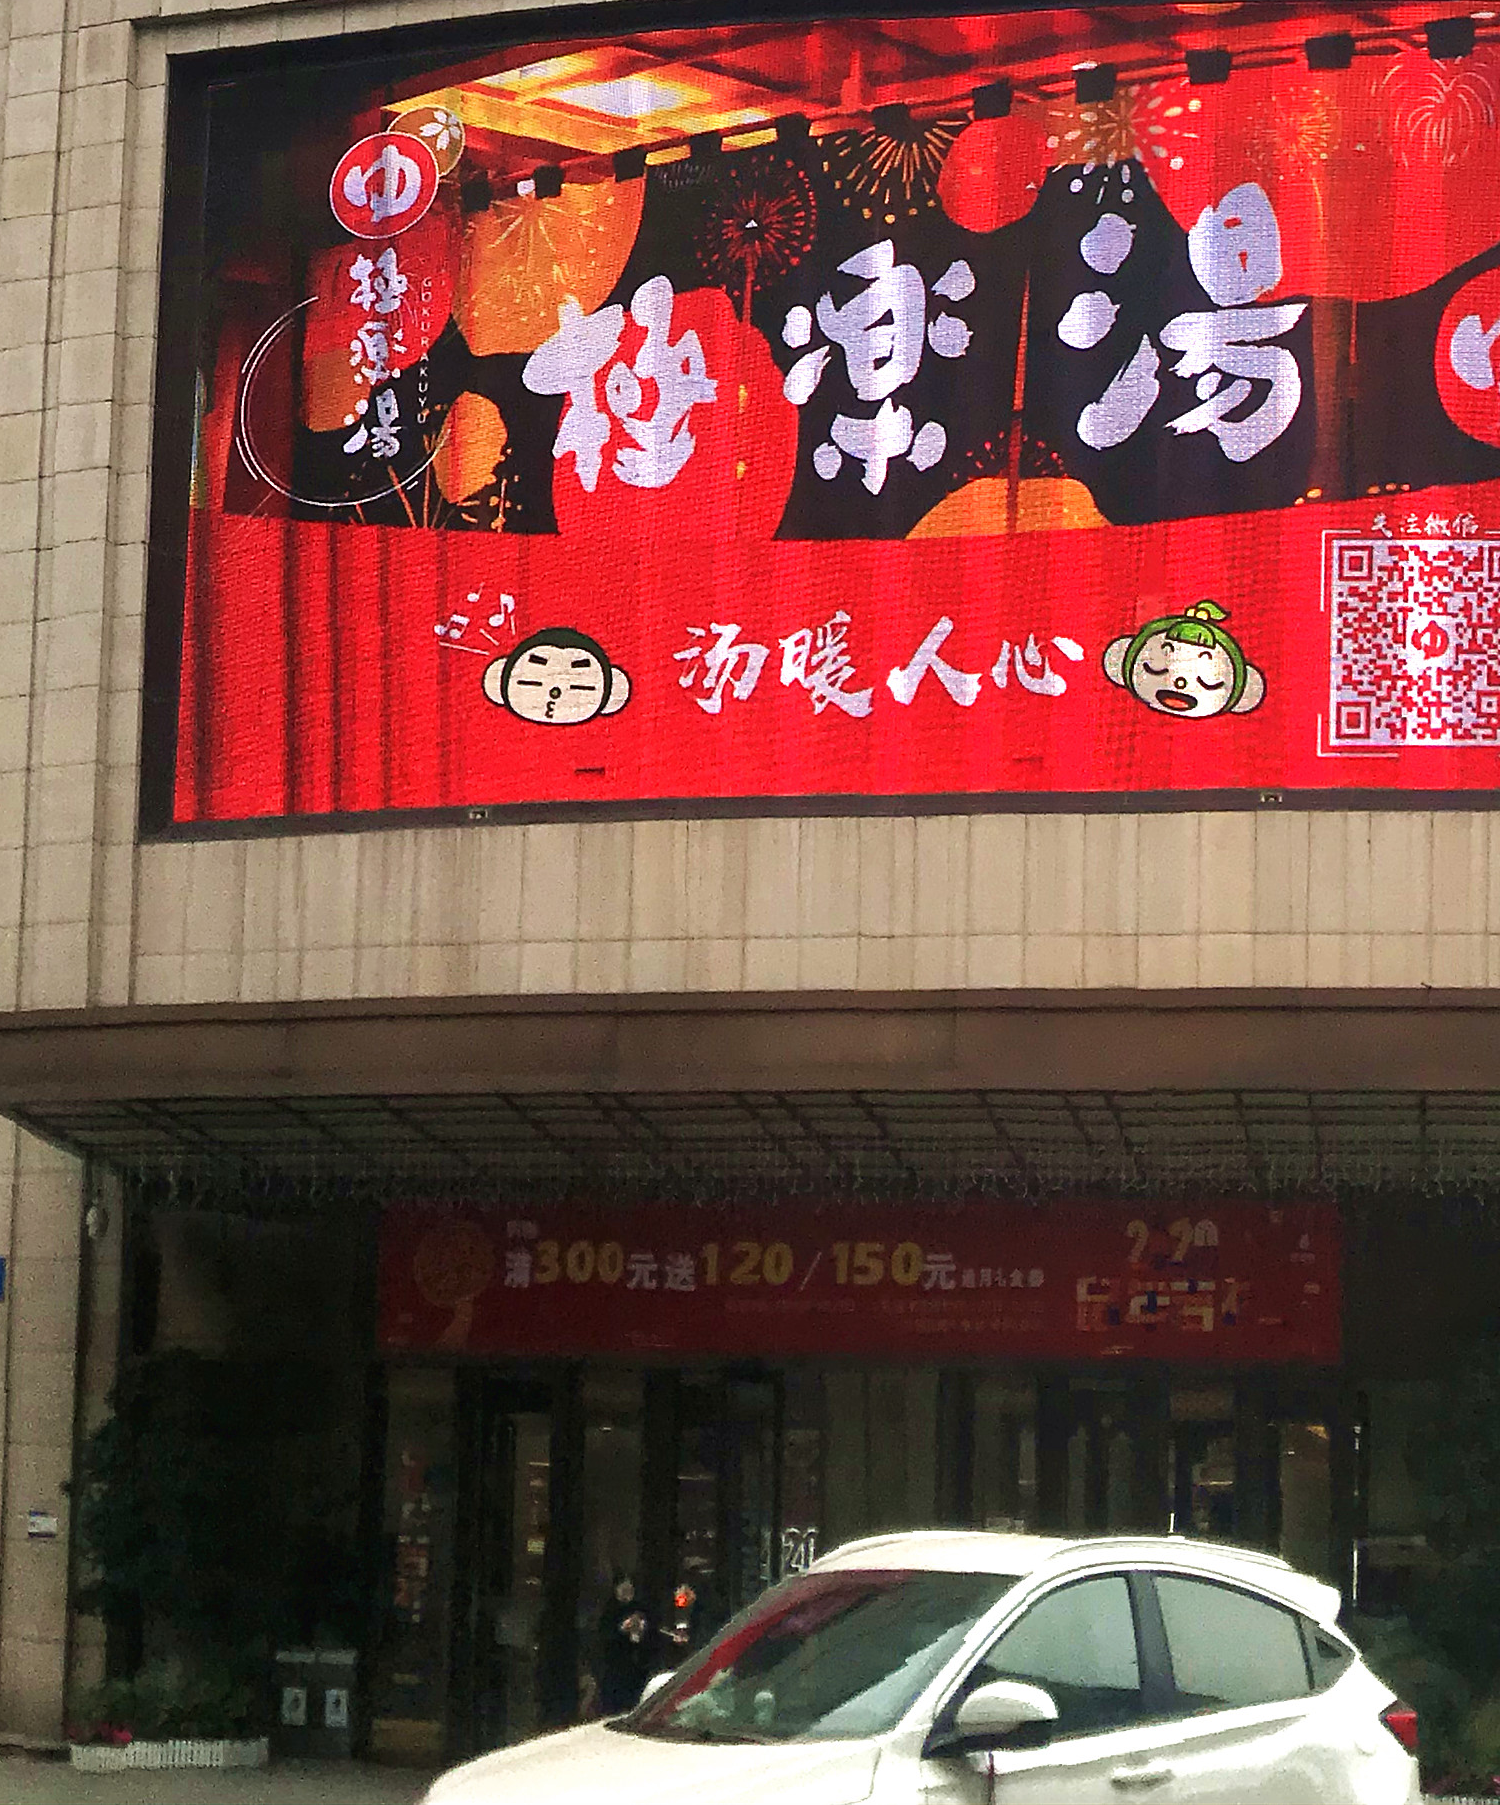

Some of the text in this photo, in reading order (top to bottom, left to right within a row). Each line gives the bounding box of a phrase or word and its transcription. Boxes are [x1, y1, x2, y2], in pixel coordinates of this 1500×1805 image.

[417, 278, 432, 425] GOKURAKUYU
[1370, 512, 1479, 538] 关注微信
[675, 610, 1084, 718] 汤暖人心
